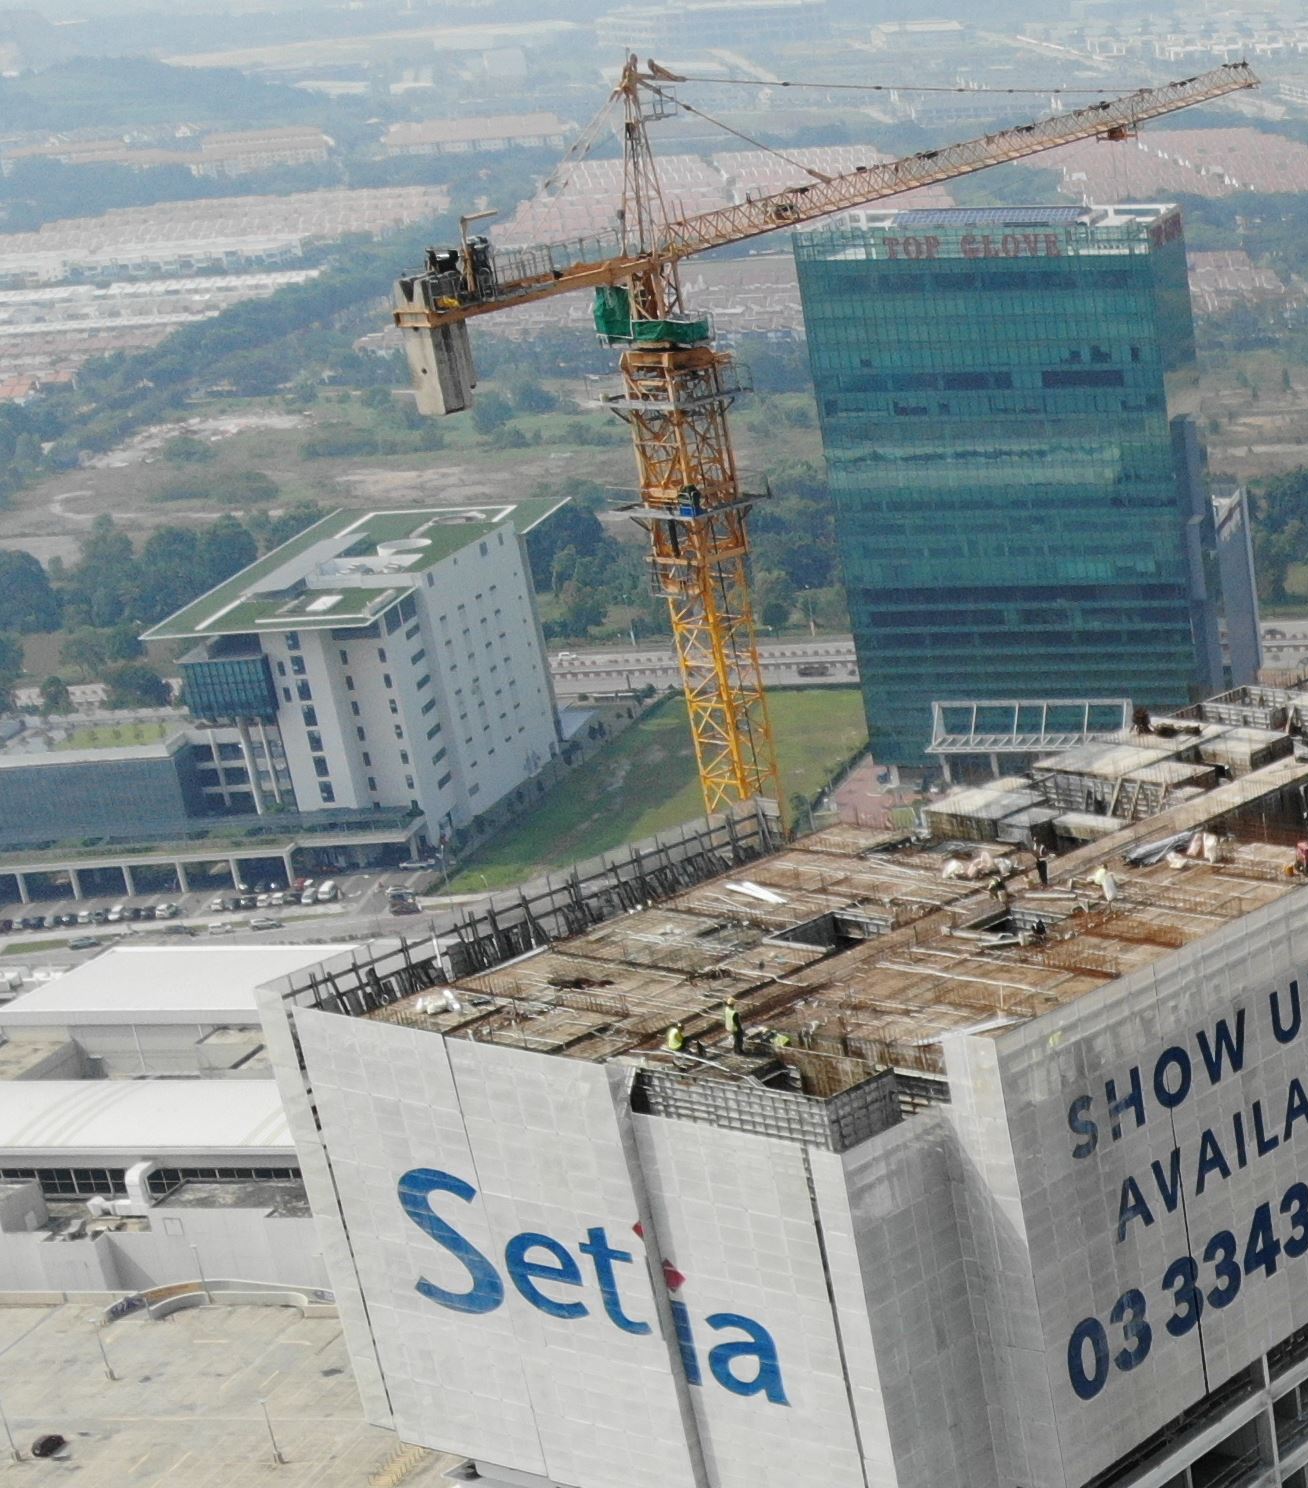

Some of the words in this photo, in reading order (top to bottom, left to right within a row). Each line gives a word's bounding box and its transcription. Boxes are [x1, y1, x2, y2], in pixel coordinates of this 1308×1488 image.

[883, 235, 940, 259] TOP
[961, 233, 1060, 259] GLOVE
[1067, 1009, 1246, 1160] SHOW
[397, 1167, 791, 1407] Setia
[1067, 1288, 1152, 1401] 03
